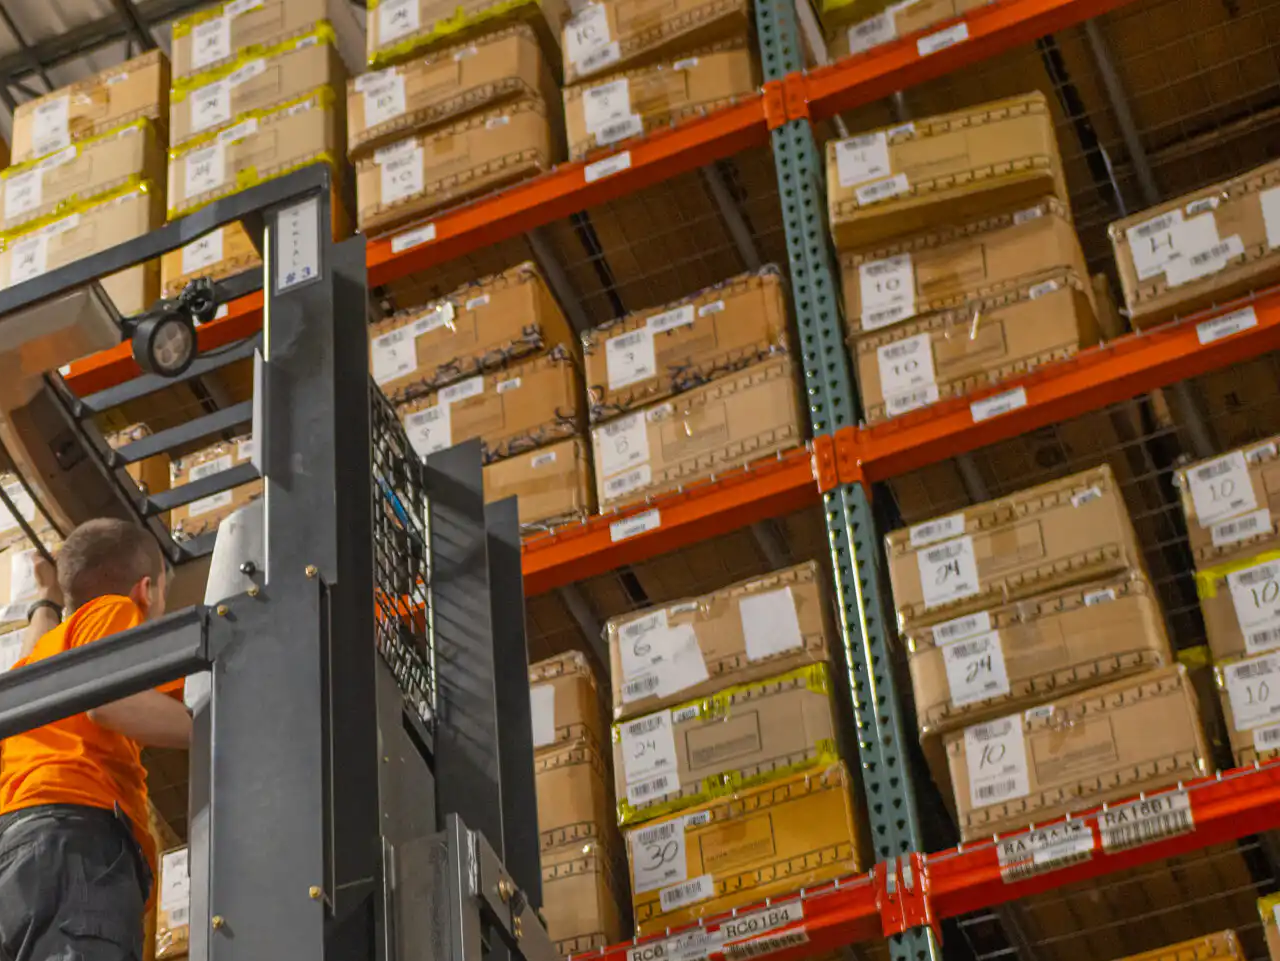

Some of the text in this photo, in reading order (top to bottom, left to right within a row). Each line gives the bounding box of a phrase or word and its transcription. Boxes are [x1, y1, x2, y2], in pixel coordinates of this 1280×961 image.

[1209, 479, 1235, 501] 10
[1251, 580, 1279, 608] 10
[1245, 680, 1270, 704] 10
[979, 743, 1006, 769] 10
[642, 840, 678, 871] 30
